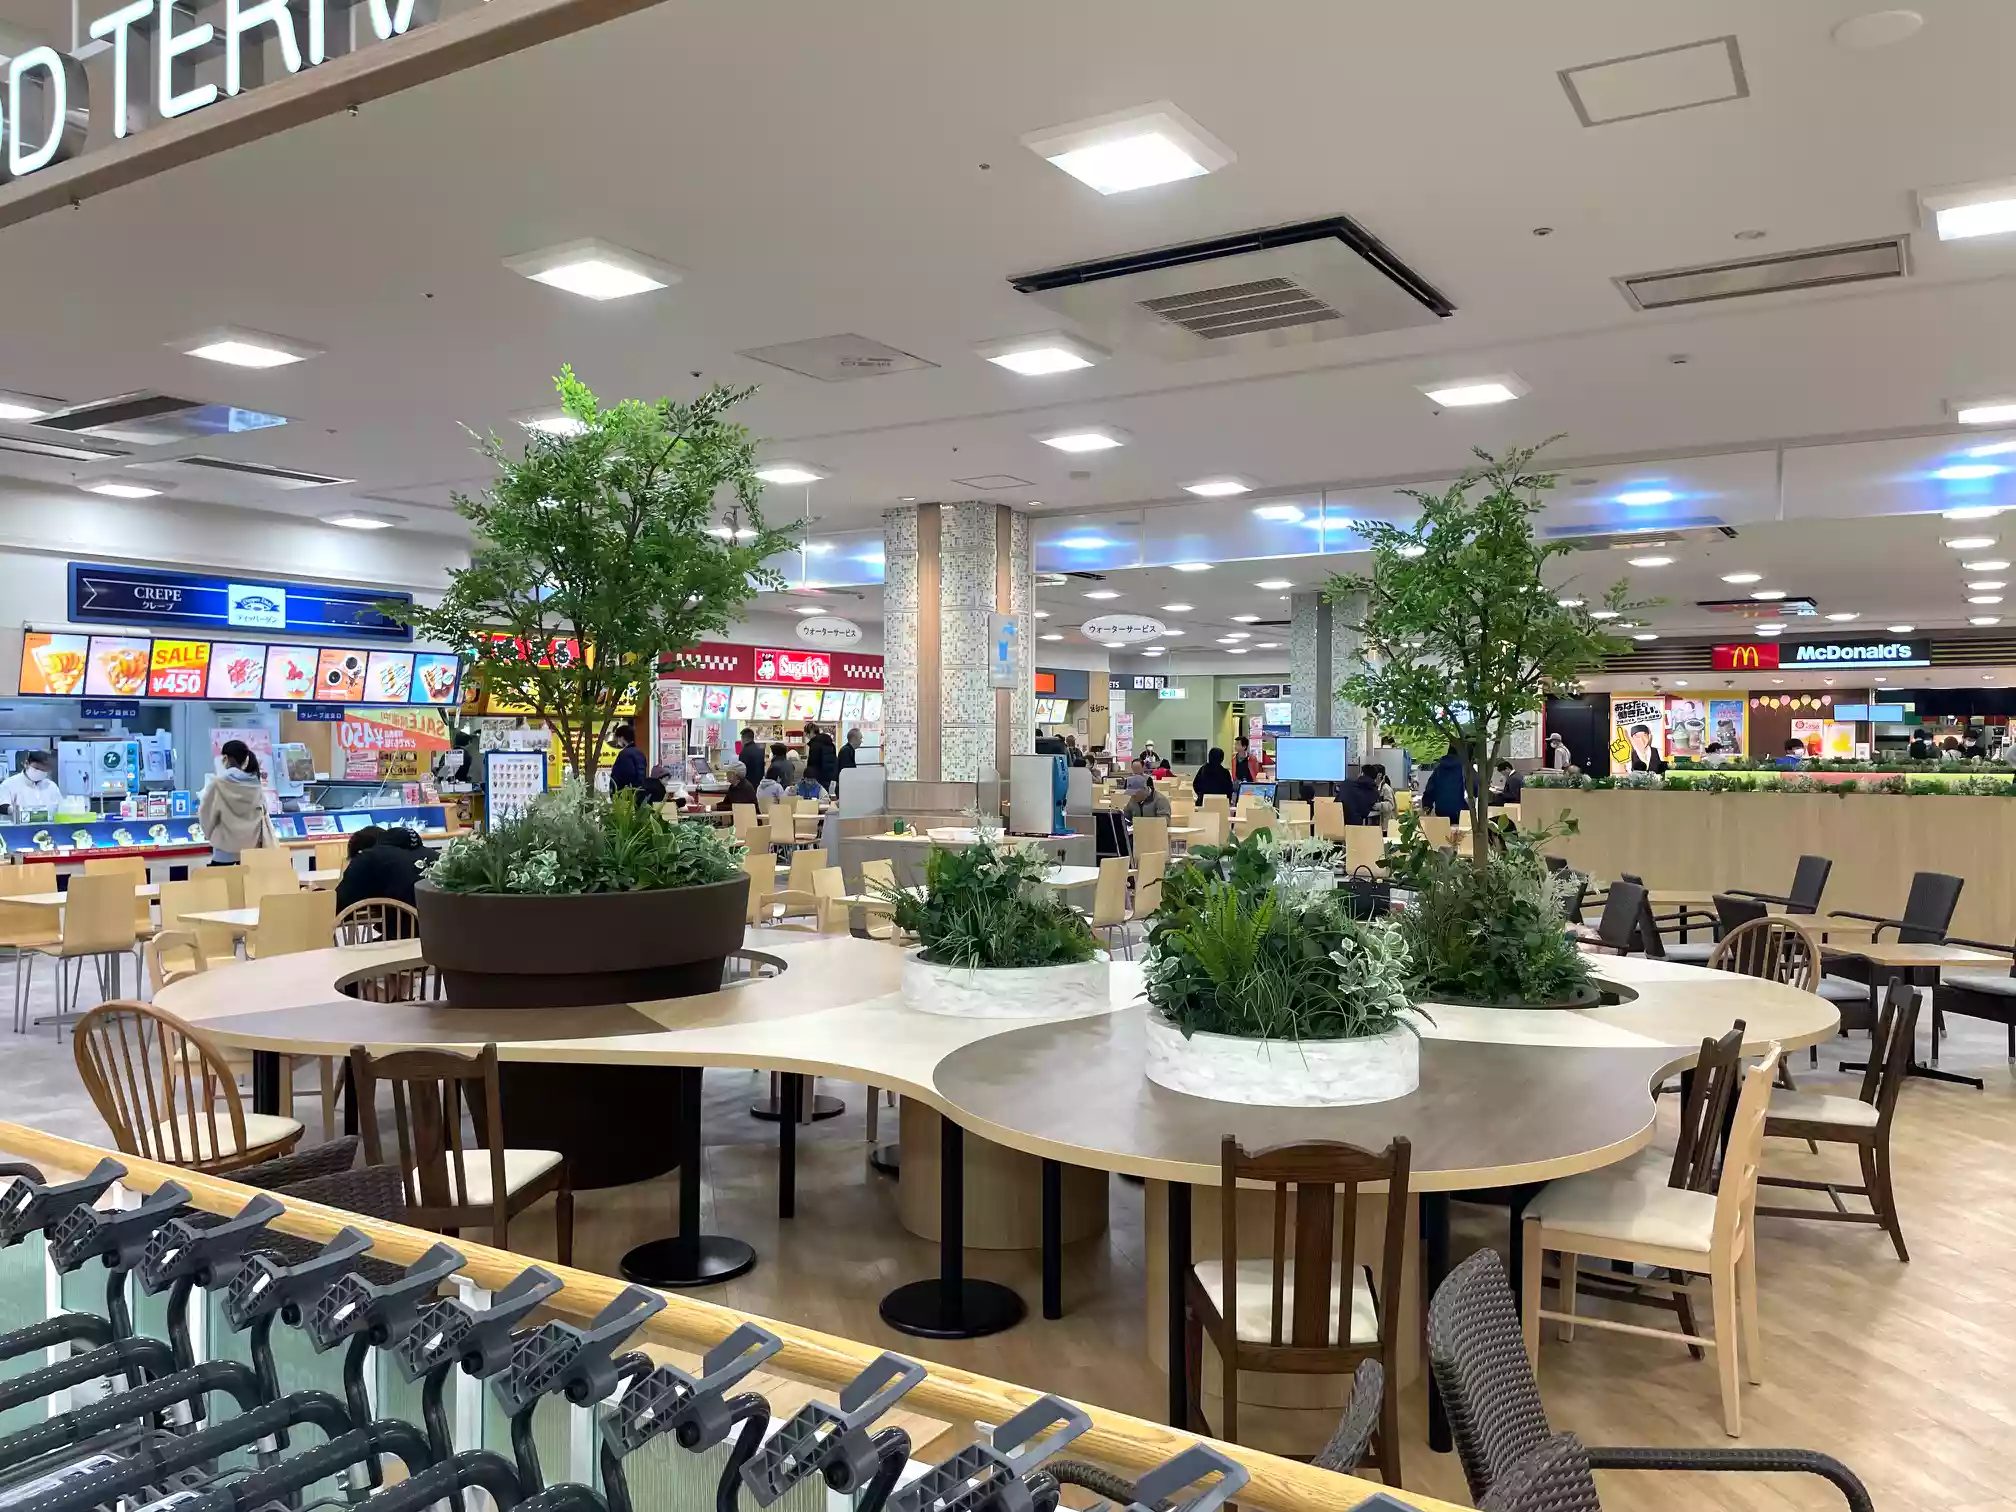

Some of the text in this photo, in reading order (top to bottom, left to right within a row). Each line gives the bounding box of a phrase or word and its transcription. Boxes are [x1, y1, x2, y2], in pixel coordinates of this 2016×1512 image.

[0, 46, 66, 176] D
[134, 587, 182, 602] CREPE
[142, 601, 174, 611] クレープ
[803, 627, 856, 638] ウォーターサービス
[1089, 624, 1156, 634] ウォーターサービス
[155, 644, 206, 665] SALE
[1796, 643, 1912, 660] McDonald's
[153, 674, 201, 694] ¥450
[1615, 700, 1649, 711] あなたと
